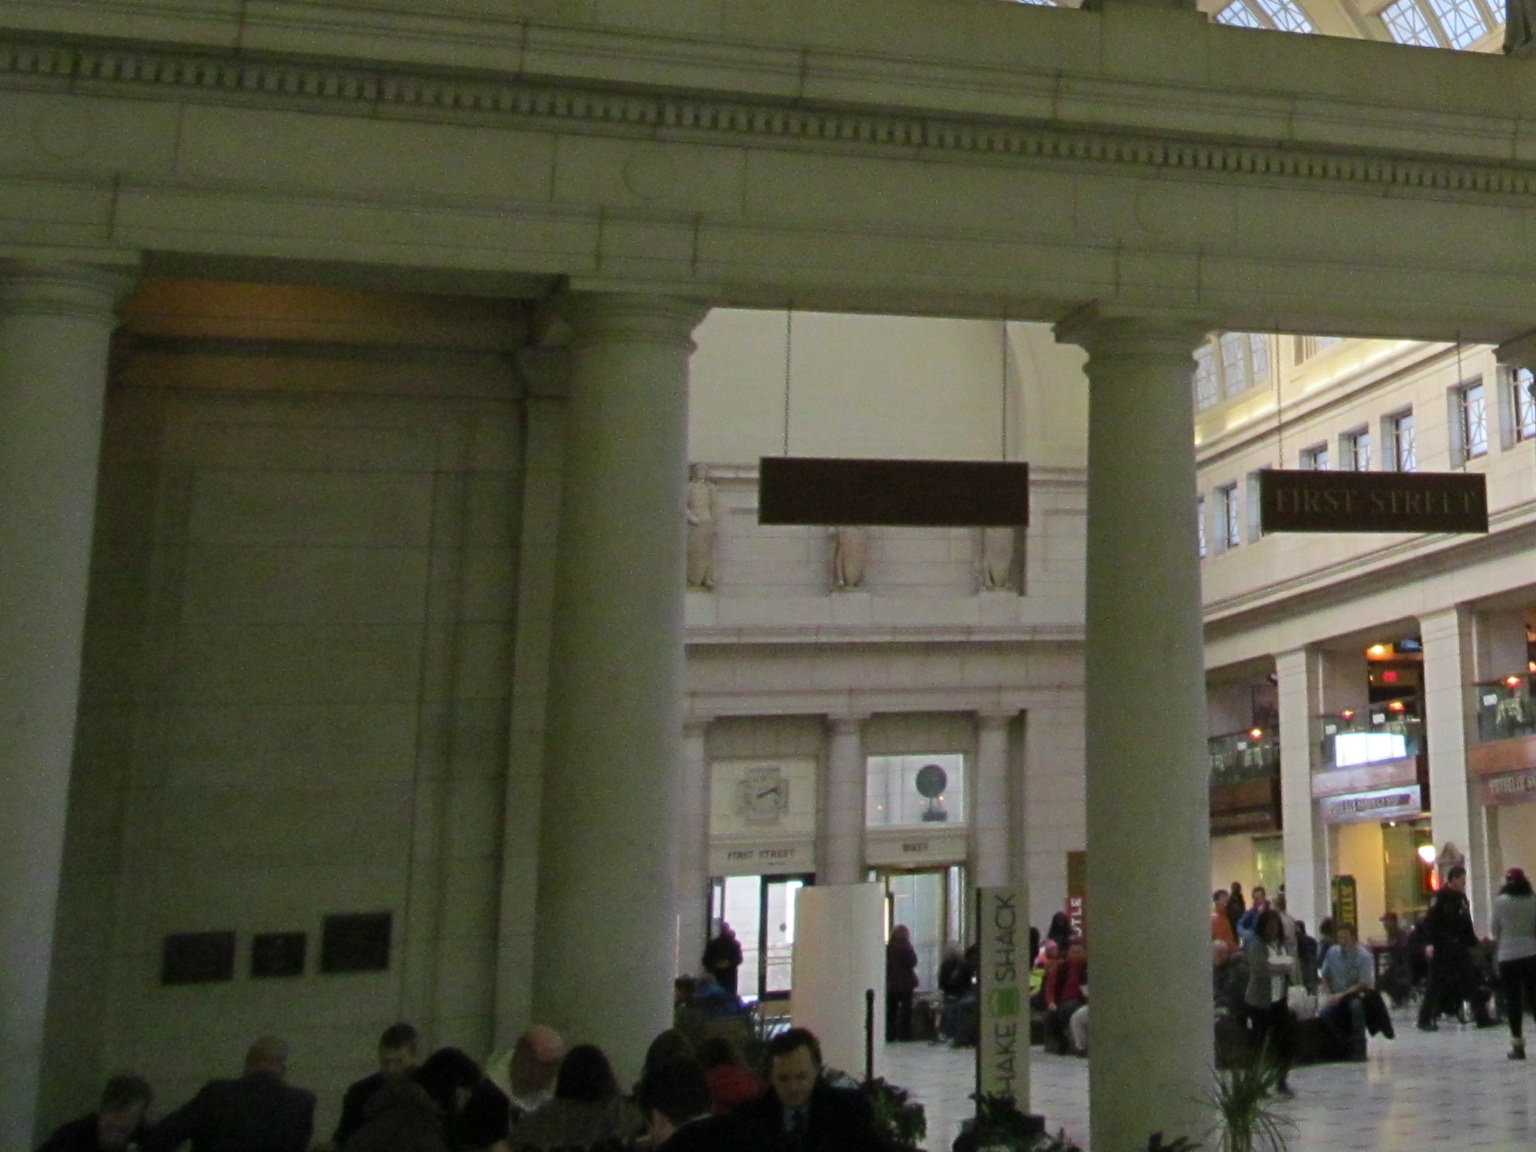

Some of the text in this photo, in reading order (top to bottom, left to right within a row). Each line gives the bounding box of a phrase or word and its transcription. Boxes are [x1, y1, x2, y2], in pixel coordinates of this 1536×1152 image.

[1275, 487, 1477, 515] FIRST STREET
[994, 893, 1017, 1100] HAKE SHACK
